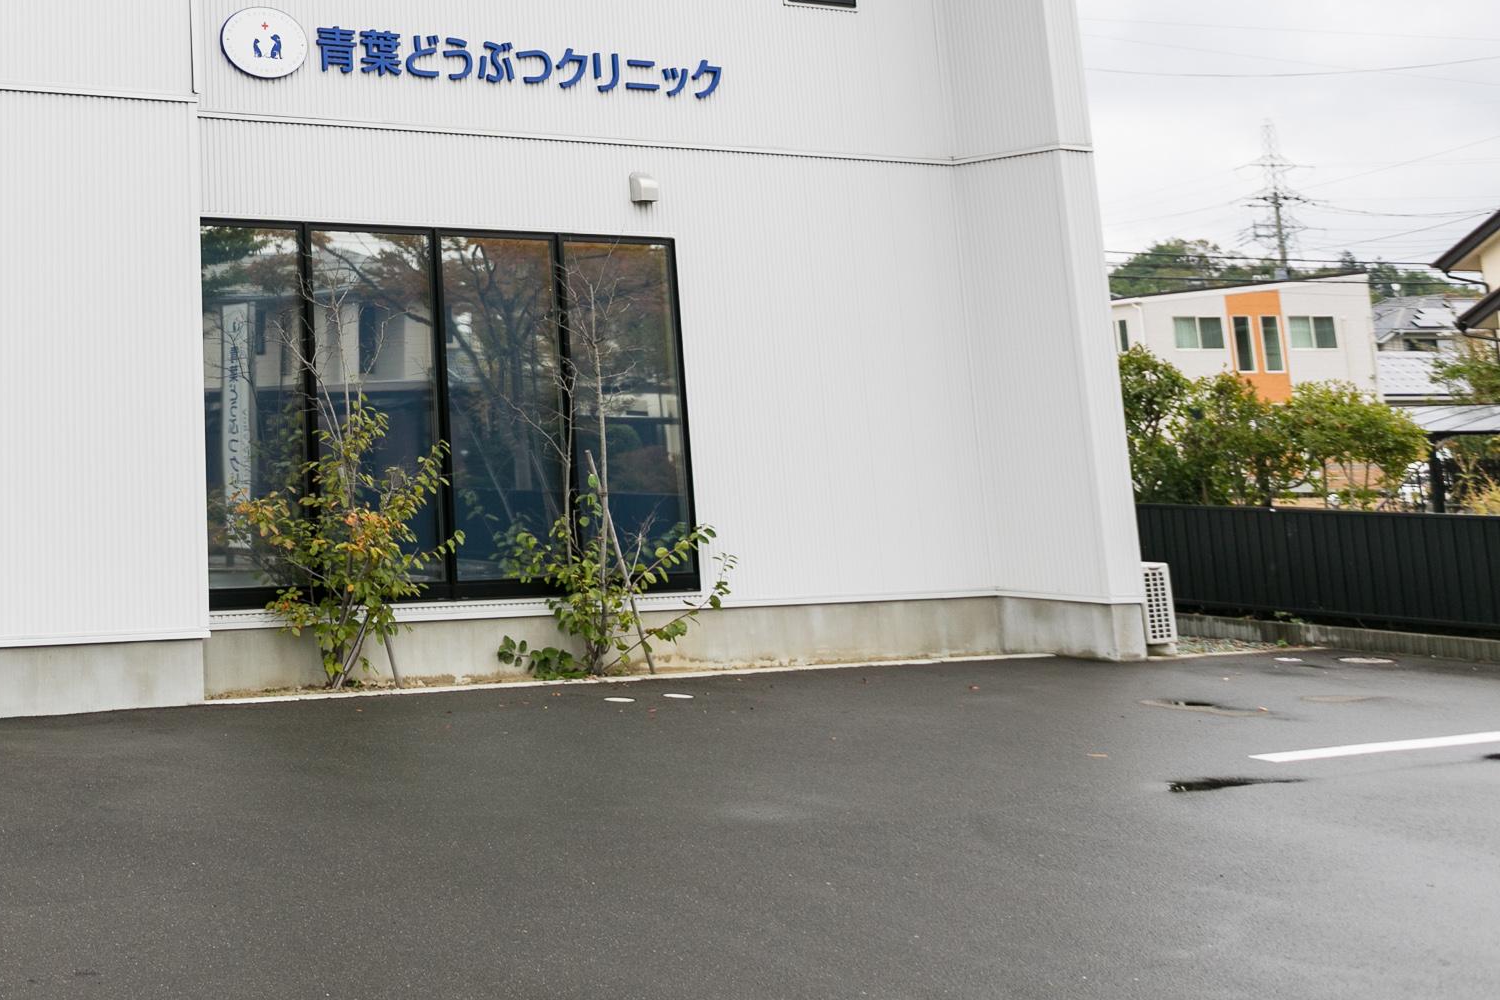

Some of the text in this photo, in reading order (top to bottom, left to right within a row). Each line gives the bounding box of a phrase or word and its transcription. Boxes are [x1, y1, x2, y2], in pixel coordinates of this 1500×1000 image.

[316, 26, 723, 98] 青葉どうぶつクリニック
